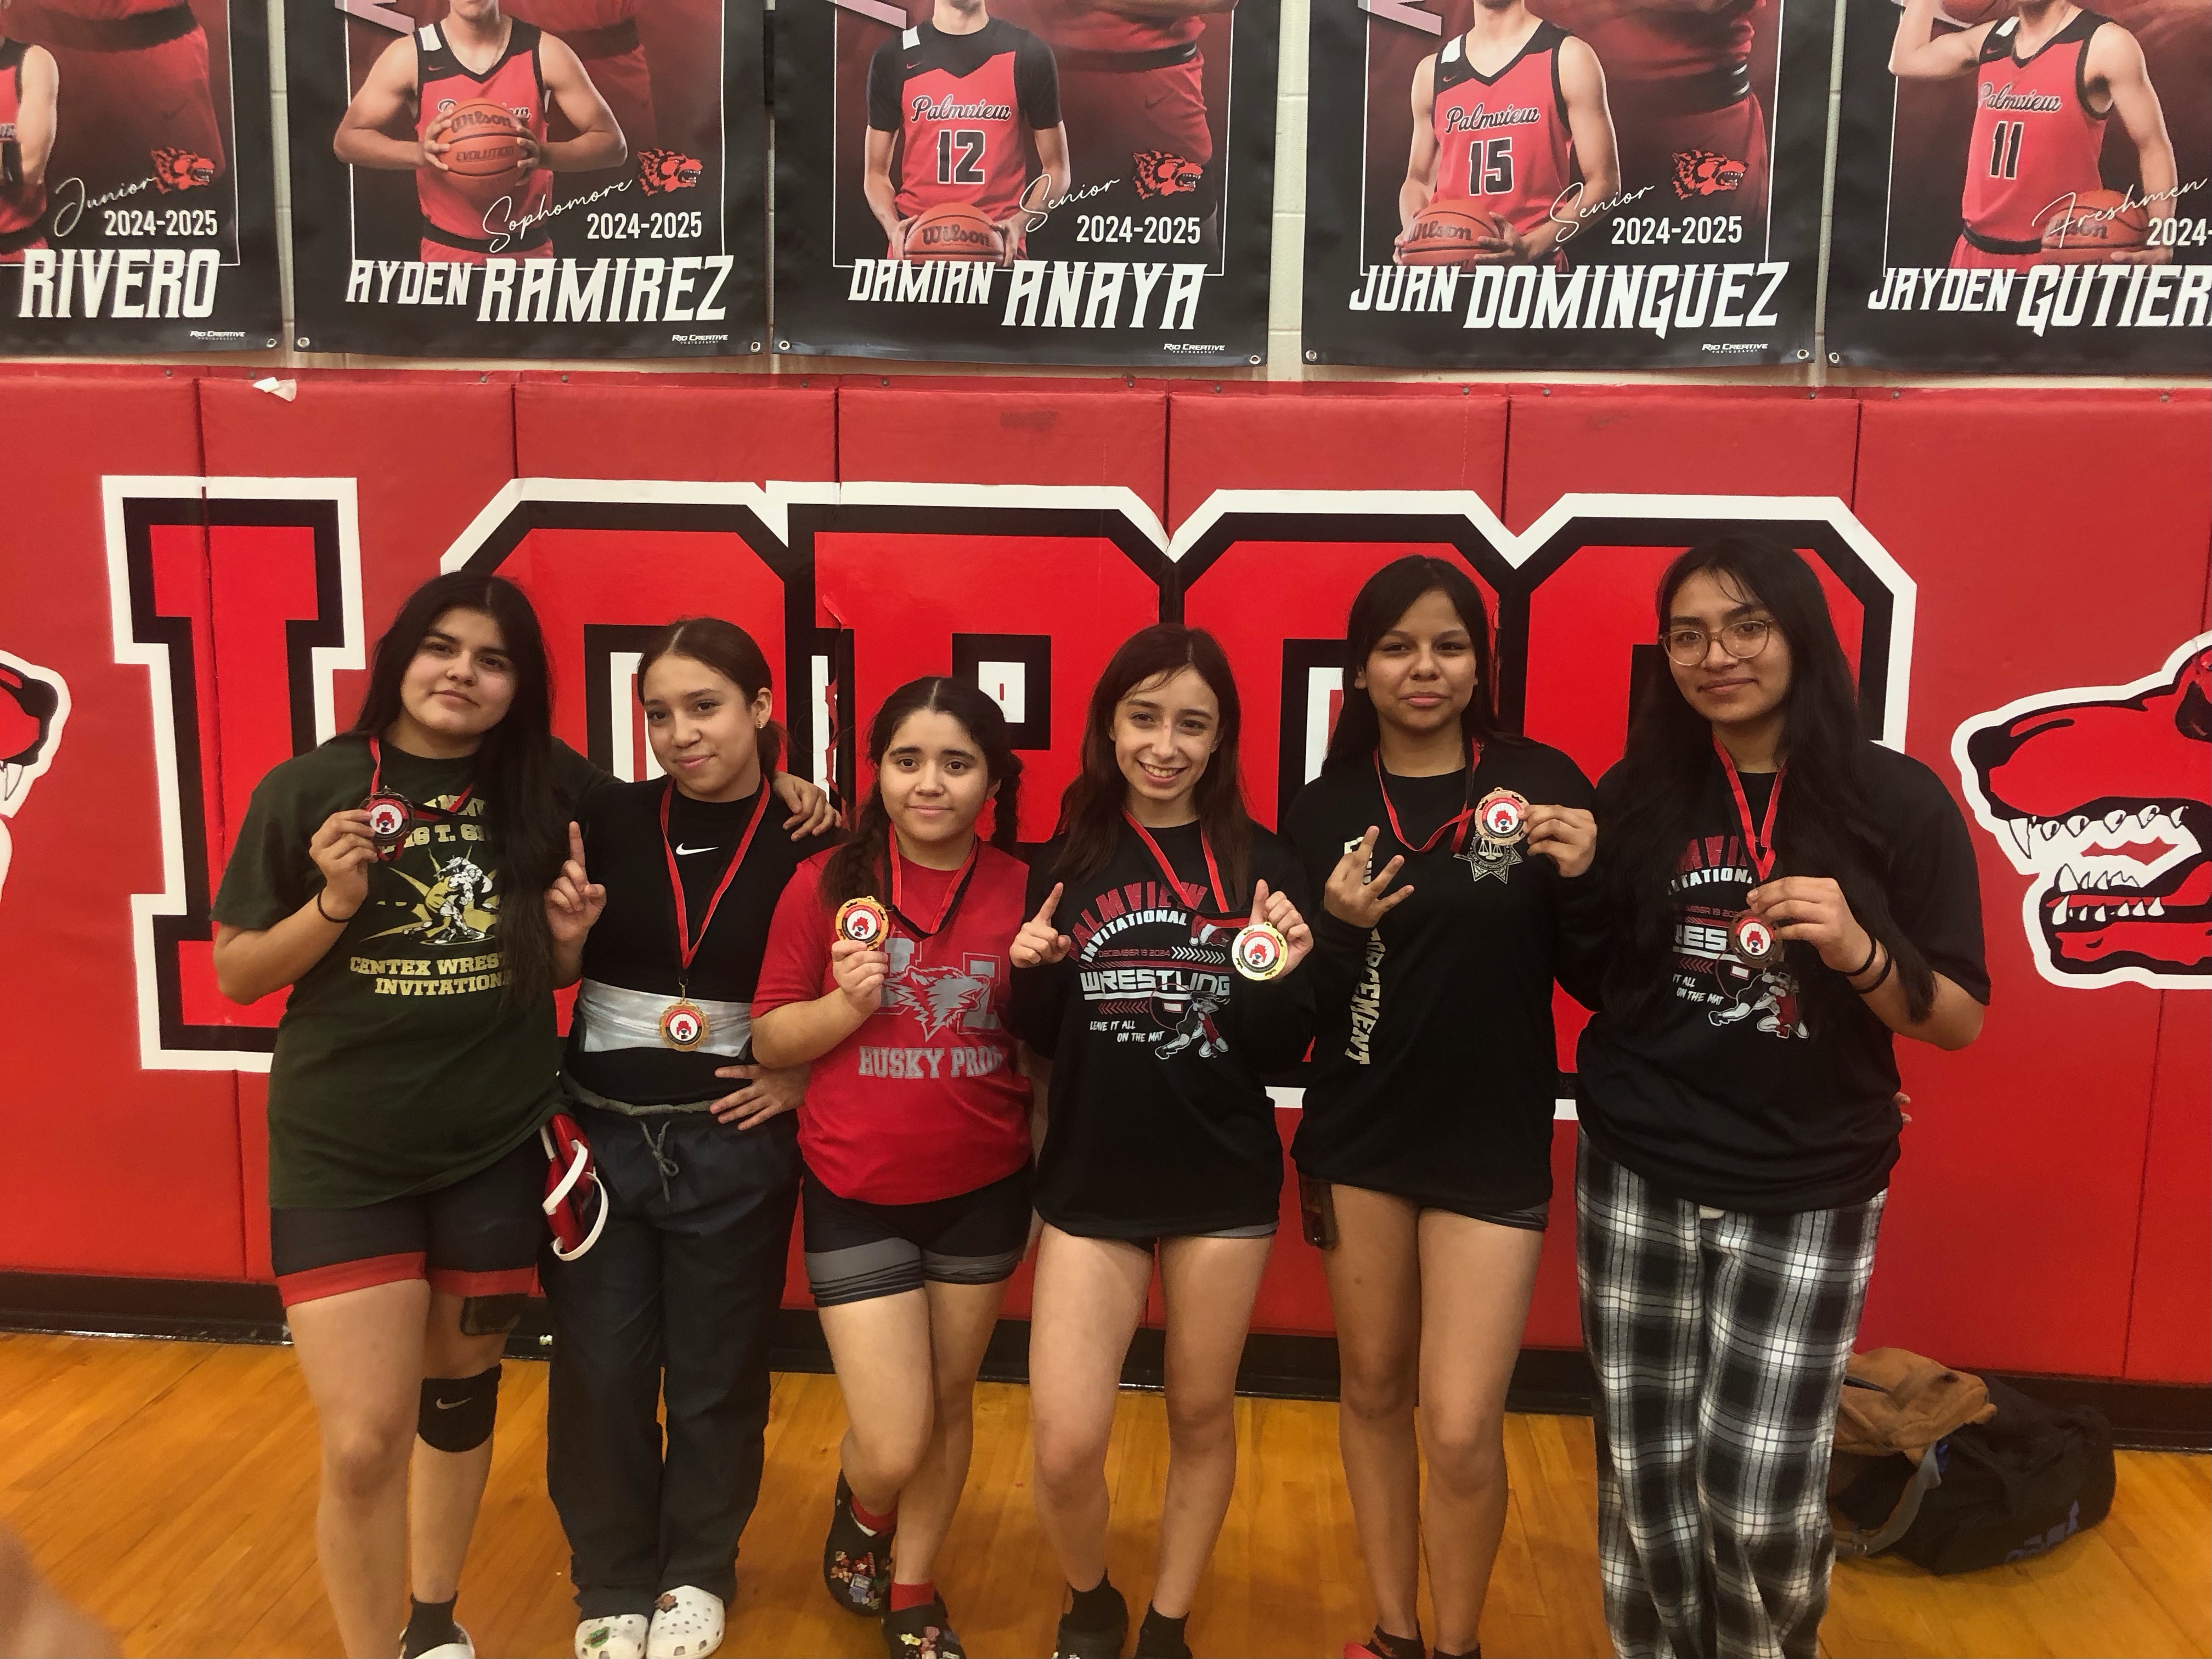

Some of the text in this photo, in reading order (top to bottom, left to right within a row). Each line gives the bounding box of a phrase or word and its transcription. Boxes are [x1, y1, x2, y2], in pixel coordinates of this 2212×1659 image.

[911, 93, 1012, 123] Palmview
[1978, 82, 2063, 114] Palmview
[450, 111, 514, 133] Wilson
[1444, 102, 1541, 133] Palmview
[936, 129, 986, 184] 12
[1989, 120, 2024, 180] 11
[1468, 137, 1514, 196] 15
[54, 177, 157, 237] Junior
[482, 178, 633, 253] Sophomore
[1019, 173, 1120, 233] Senior
[1549, 182, 1655, 243] Senior
[2032, 178, 2208, 249] Freshmen
[104, 210, 218, 236] 2024-2025
[587, 212, 702, 239] 2024-2025
[922, 224, 990, 247] Wilson
[1076, 215, 1201, 244] 2024-2025
[1611, 216, 1742, 245] 2024-2025
[18, 249, 221, 318] RIVERO
[345, 255, 734, 323] AYDEN RAMIREZ
[848, 259, 1208, 330] DAMIAN ANAYA
[1349, 262, 1790, 340] JUAN DOMINGUEZ
[1867, 264, 2212, 338] JAYDEN GUTIER
[1080, 909, 1187, 963] INVITATIONAL
[349, 956, 432, 976] CENTEX
[1098, 949, 1139, 958] DECEMBER
[1080, 969, 1231, 996] WRESTLING
[1672, 973, 1696, 988] IT ALL
[1676, 987, 1724, 1006] ON THE MAT
[1089, 1019, 1136, 1031] LEAVE IT ALL
[1116, 1031, 1165, 1043] ON THE MAT
[858, 1045, 945, 1080] HUSKY
